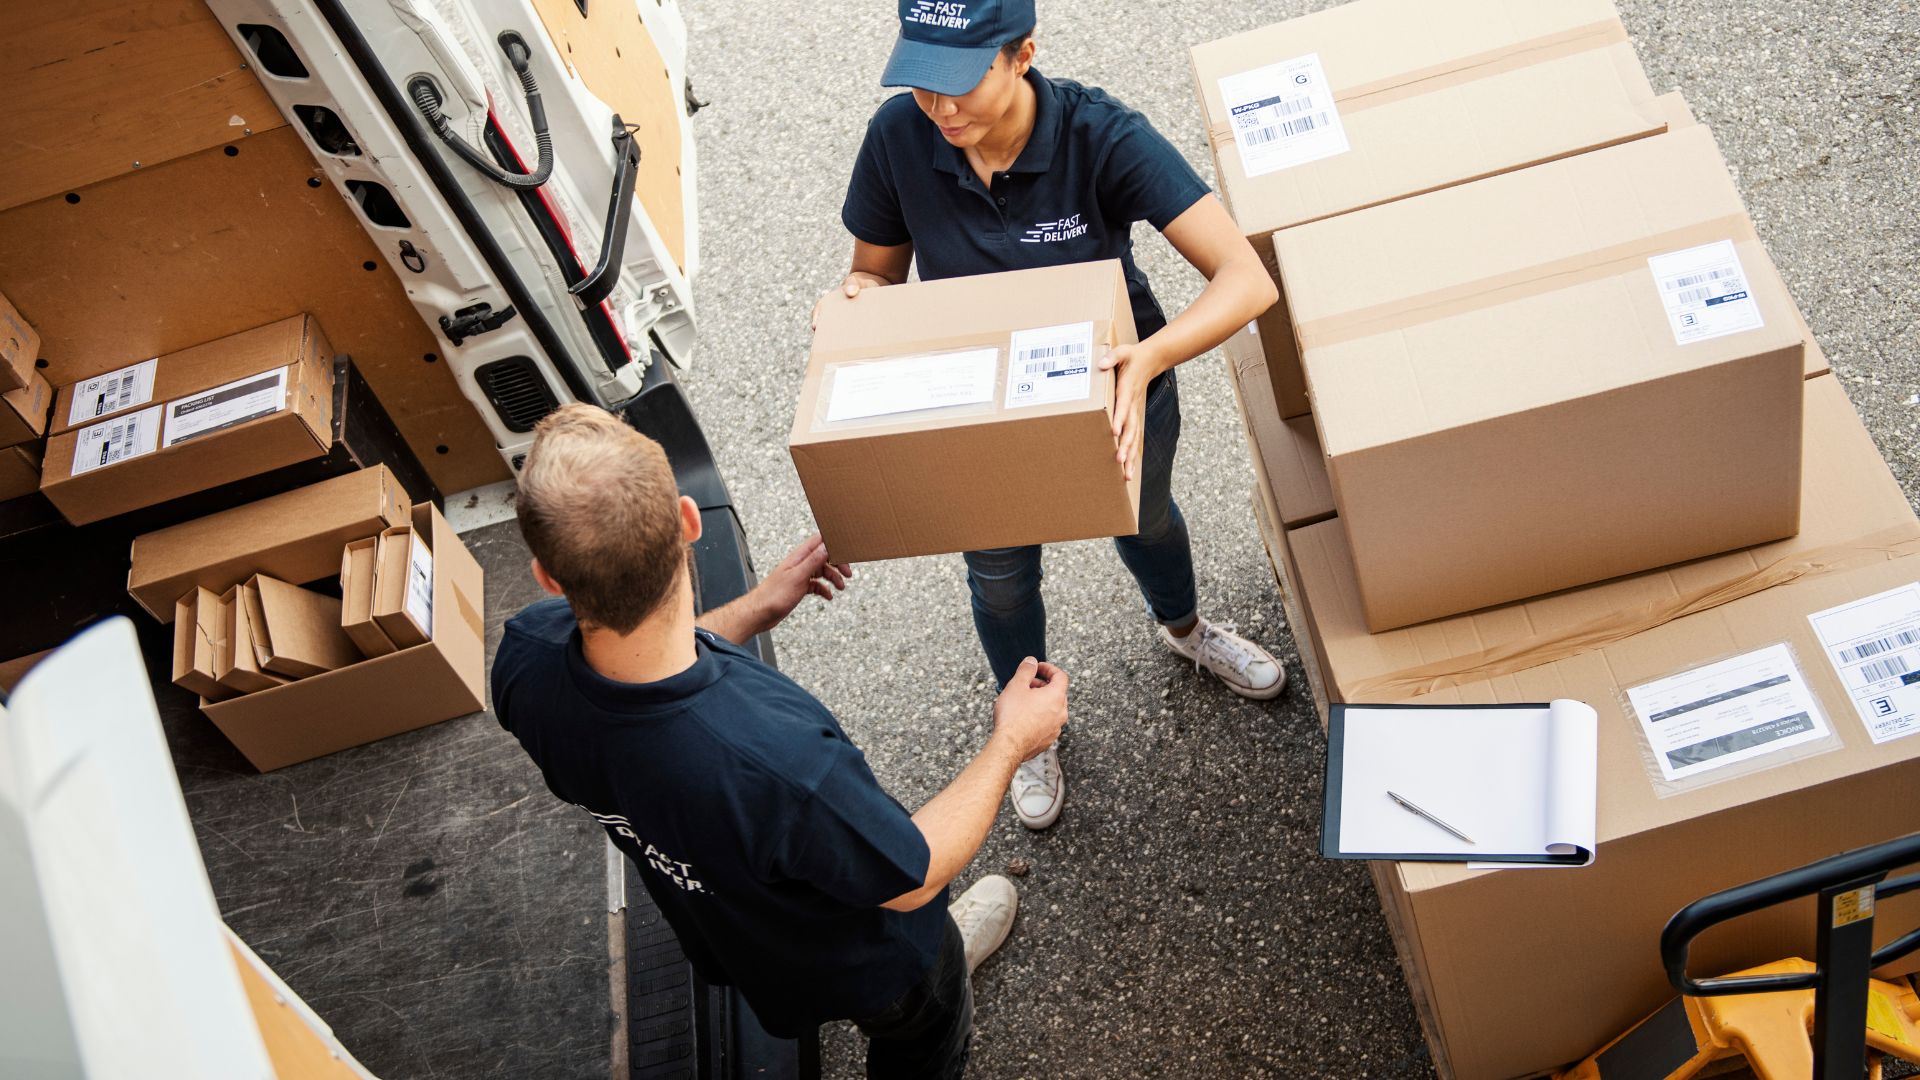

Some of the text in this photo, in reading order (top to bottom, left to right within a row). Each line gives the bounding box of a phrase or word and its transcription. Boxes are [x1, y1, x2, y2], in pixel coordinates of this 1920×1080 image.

[935, 1, 966, 17] FAST
[920, 12, 971, 30] DELIVERY
[1295, 74, 1308, 85] G
[1058, 213, 1081, 231] FAST
[1043, 223, 1089, 243] DELIVERY
[1683, 315, 1694, 325] E
[204, 395, 216, 403] LIST
[1876, 699, 1892, 714] E
[1774, 723, 1805, 737] INVOICE
[1875, 717, 1903, 729] DELIVERY
